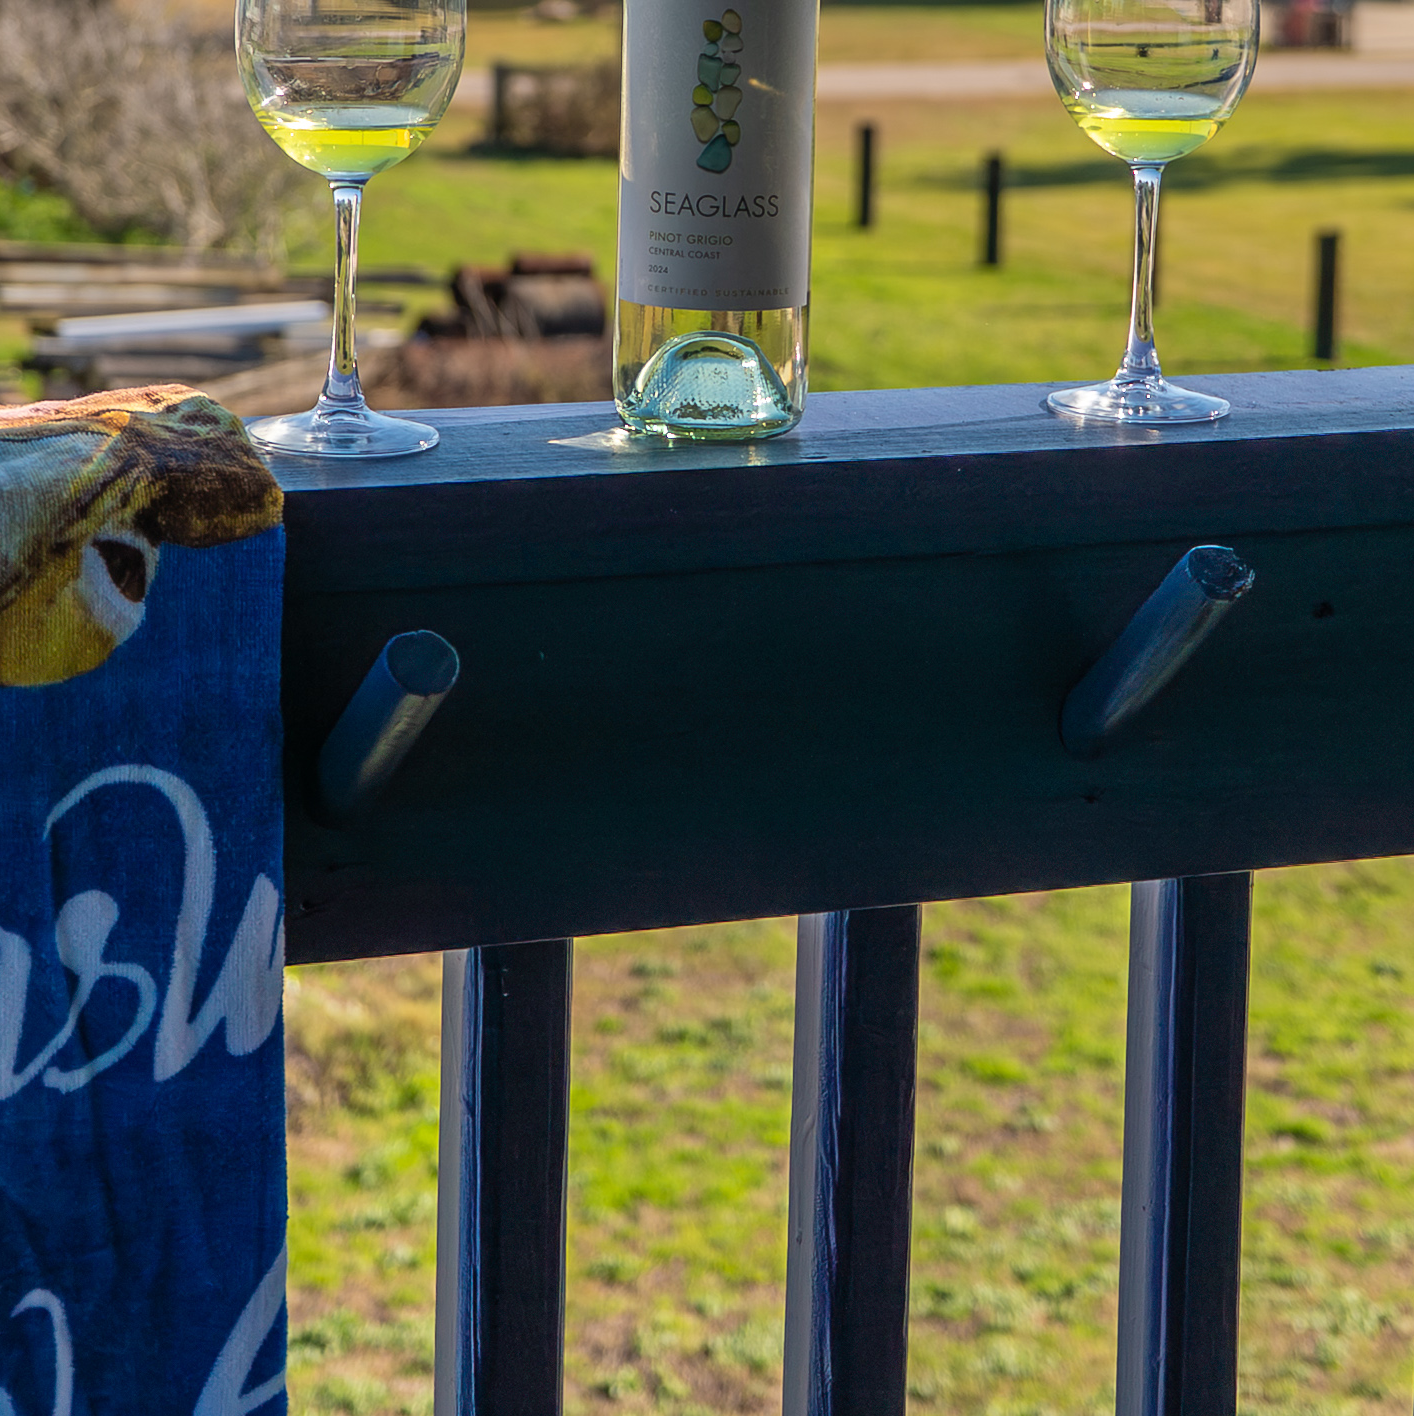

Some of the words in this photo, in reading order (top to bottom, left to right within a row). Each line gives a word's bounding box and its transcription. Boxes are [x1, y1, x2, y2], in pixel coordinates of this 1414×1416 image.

[649, 190, 779, 219] SEAGLASS
[648, 230, 682, 244] PINOT
[686, 233, 734, 246] GRIGIO
[648, 246, 685, 259] CENTRAL
[687, 249, 721, 260] COAST
[648, 263, 669, 274] 2024
[647, 284, 708, 297] CERTIFIED
[715, 287, 789, 298] SUSTAINABLE
